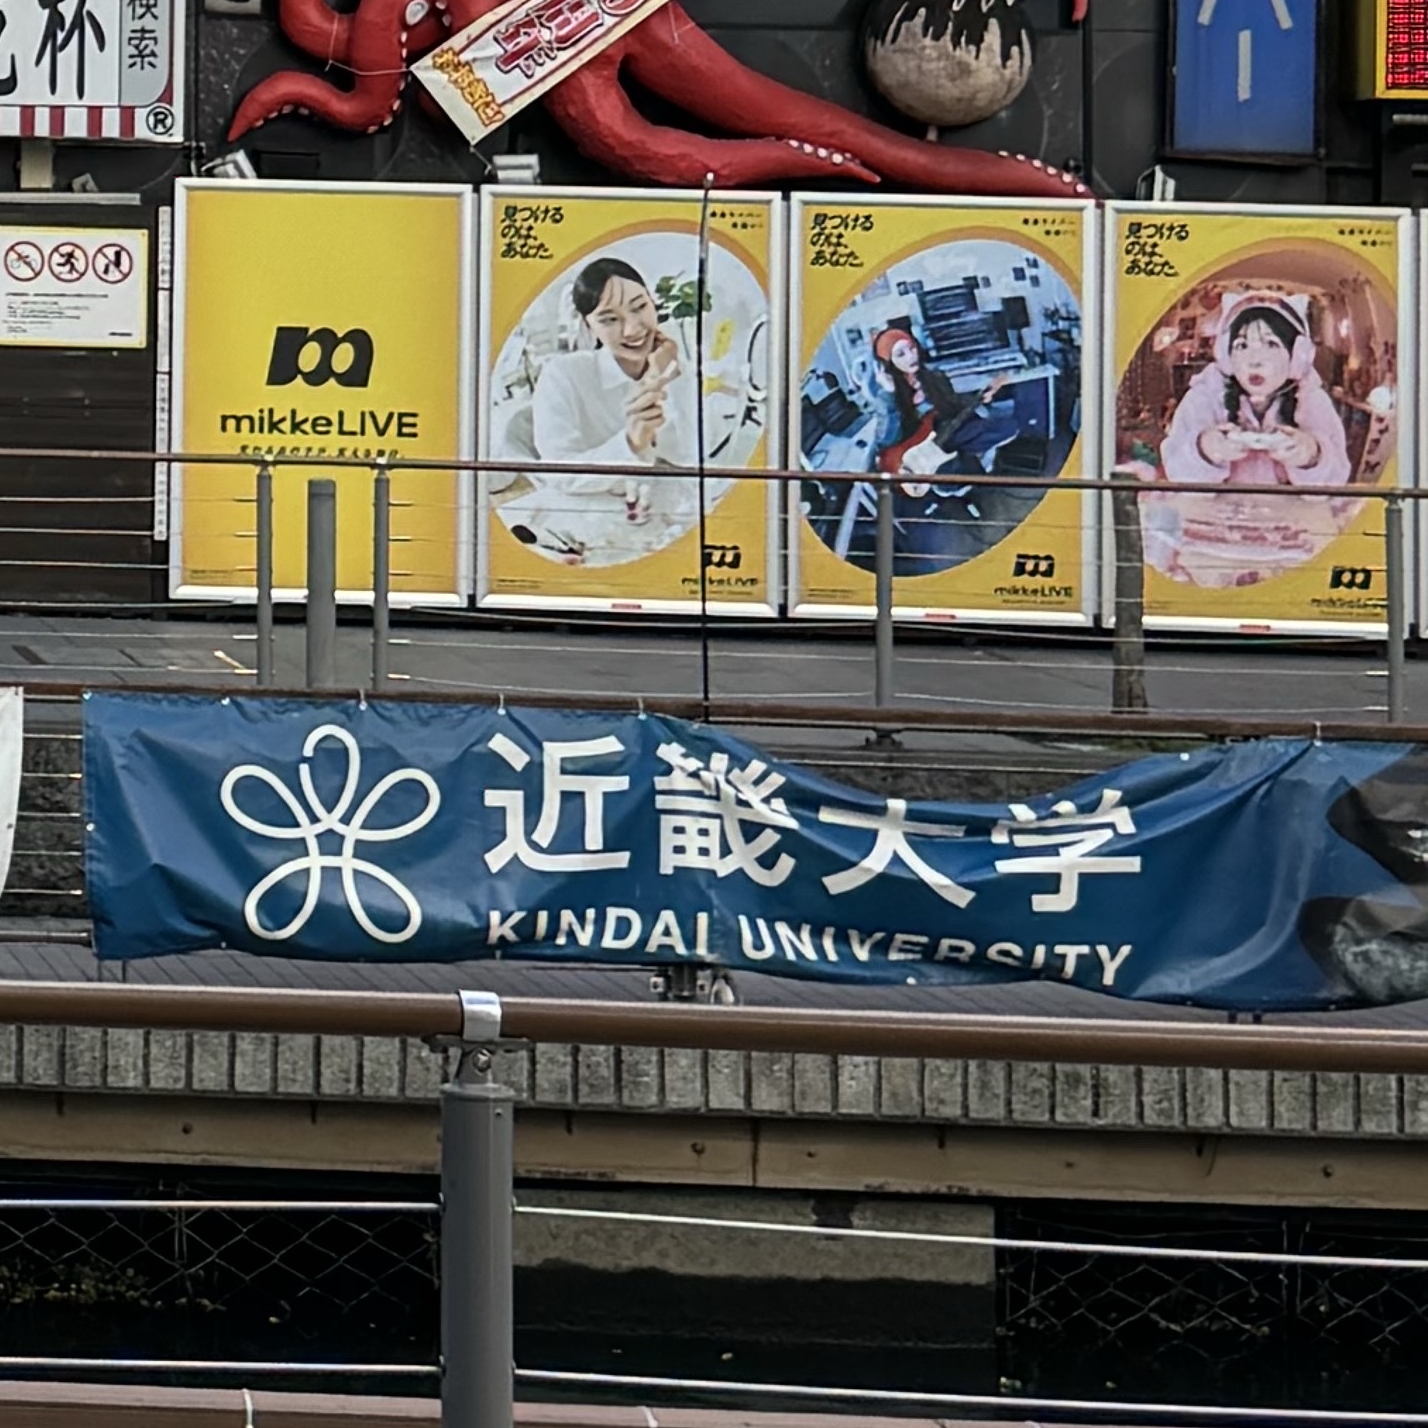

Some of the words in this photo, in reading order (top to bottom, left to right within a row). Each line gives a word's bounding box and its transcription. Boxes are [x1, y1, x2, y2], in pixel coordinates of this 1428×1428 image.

[501, 205, 565, 225] 見つける
[810, 212, 875, 232] 見つける
[1125, 222, 1189, 241] 見つける
[219, 407, 420, 439] mikkeLIVE
[481, 727, 1143, 914] 近畿大学
[487, 908, 709, 958] KINDAI
[738, 914, 1134, 987] UNIVERSITY
